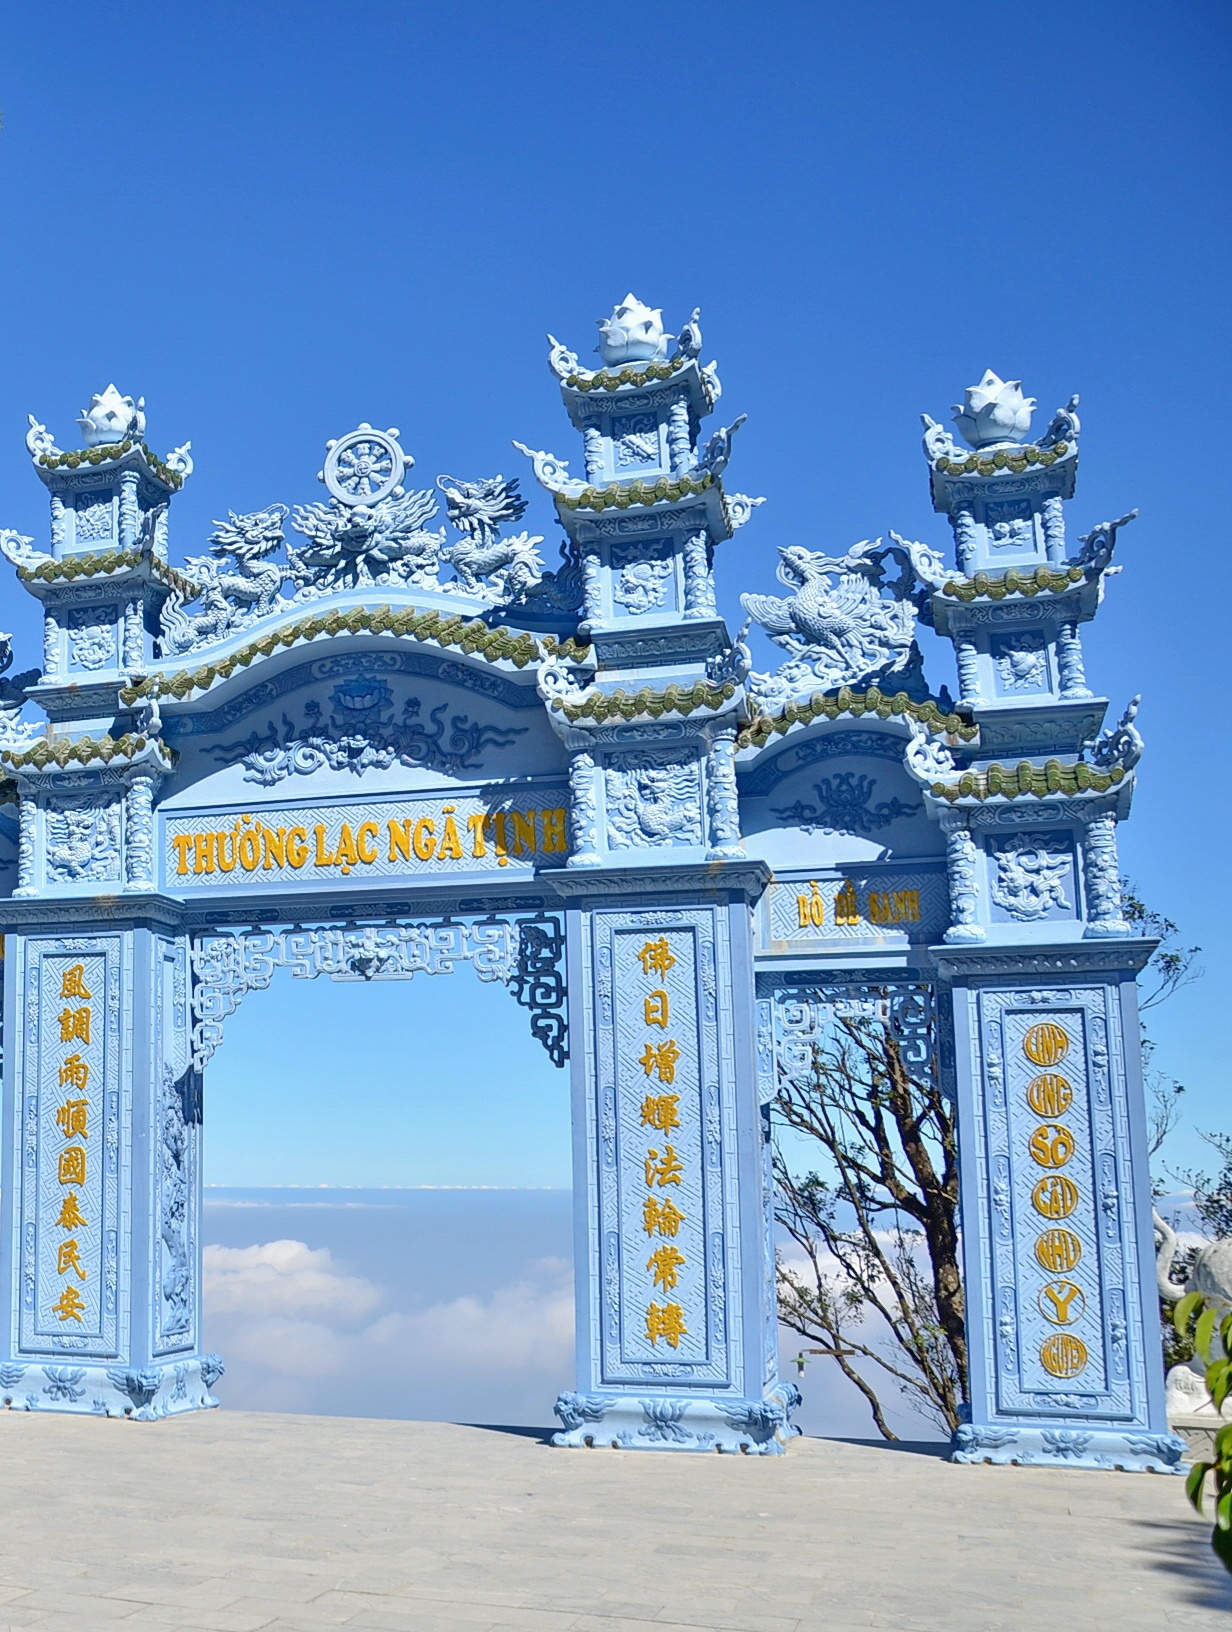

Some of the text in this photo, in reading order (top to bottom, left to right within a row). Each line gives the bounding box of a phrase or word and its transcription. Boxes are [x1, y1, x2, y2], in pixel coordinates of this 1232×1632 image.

[173, 805, 568, 875] THƯỜNG LẠC NGÃ TỊNH
[796, 878, 921, 928] BỒ ĐỀ SANH
[1025, 1023, 1068, 1065] LINH
[51, 963, 93, 1323] 風調雨順國泰民安
[637, 935, 688, 1350] 佛日增輝法輪常轉
[1030, 1124, 1074, 1167] SỞ
[1044, 1282, 1080, 1323] Ý
